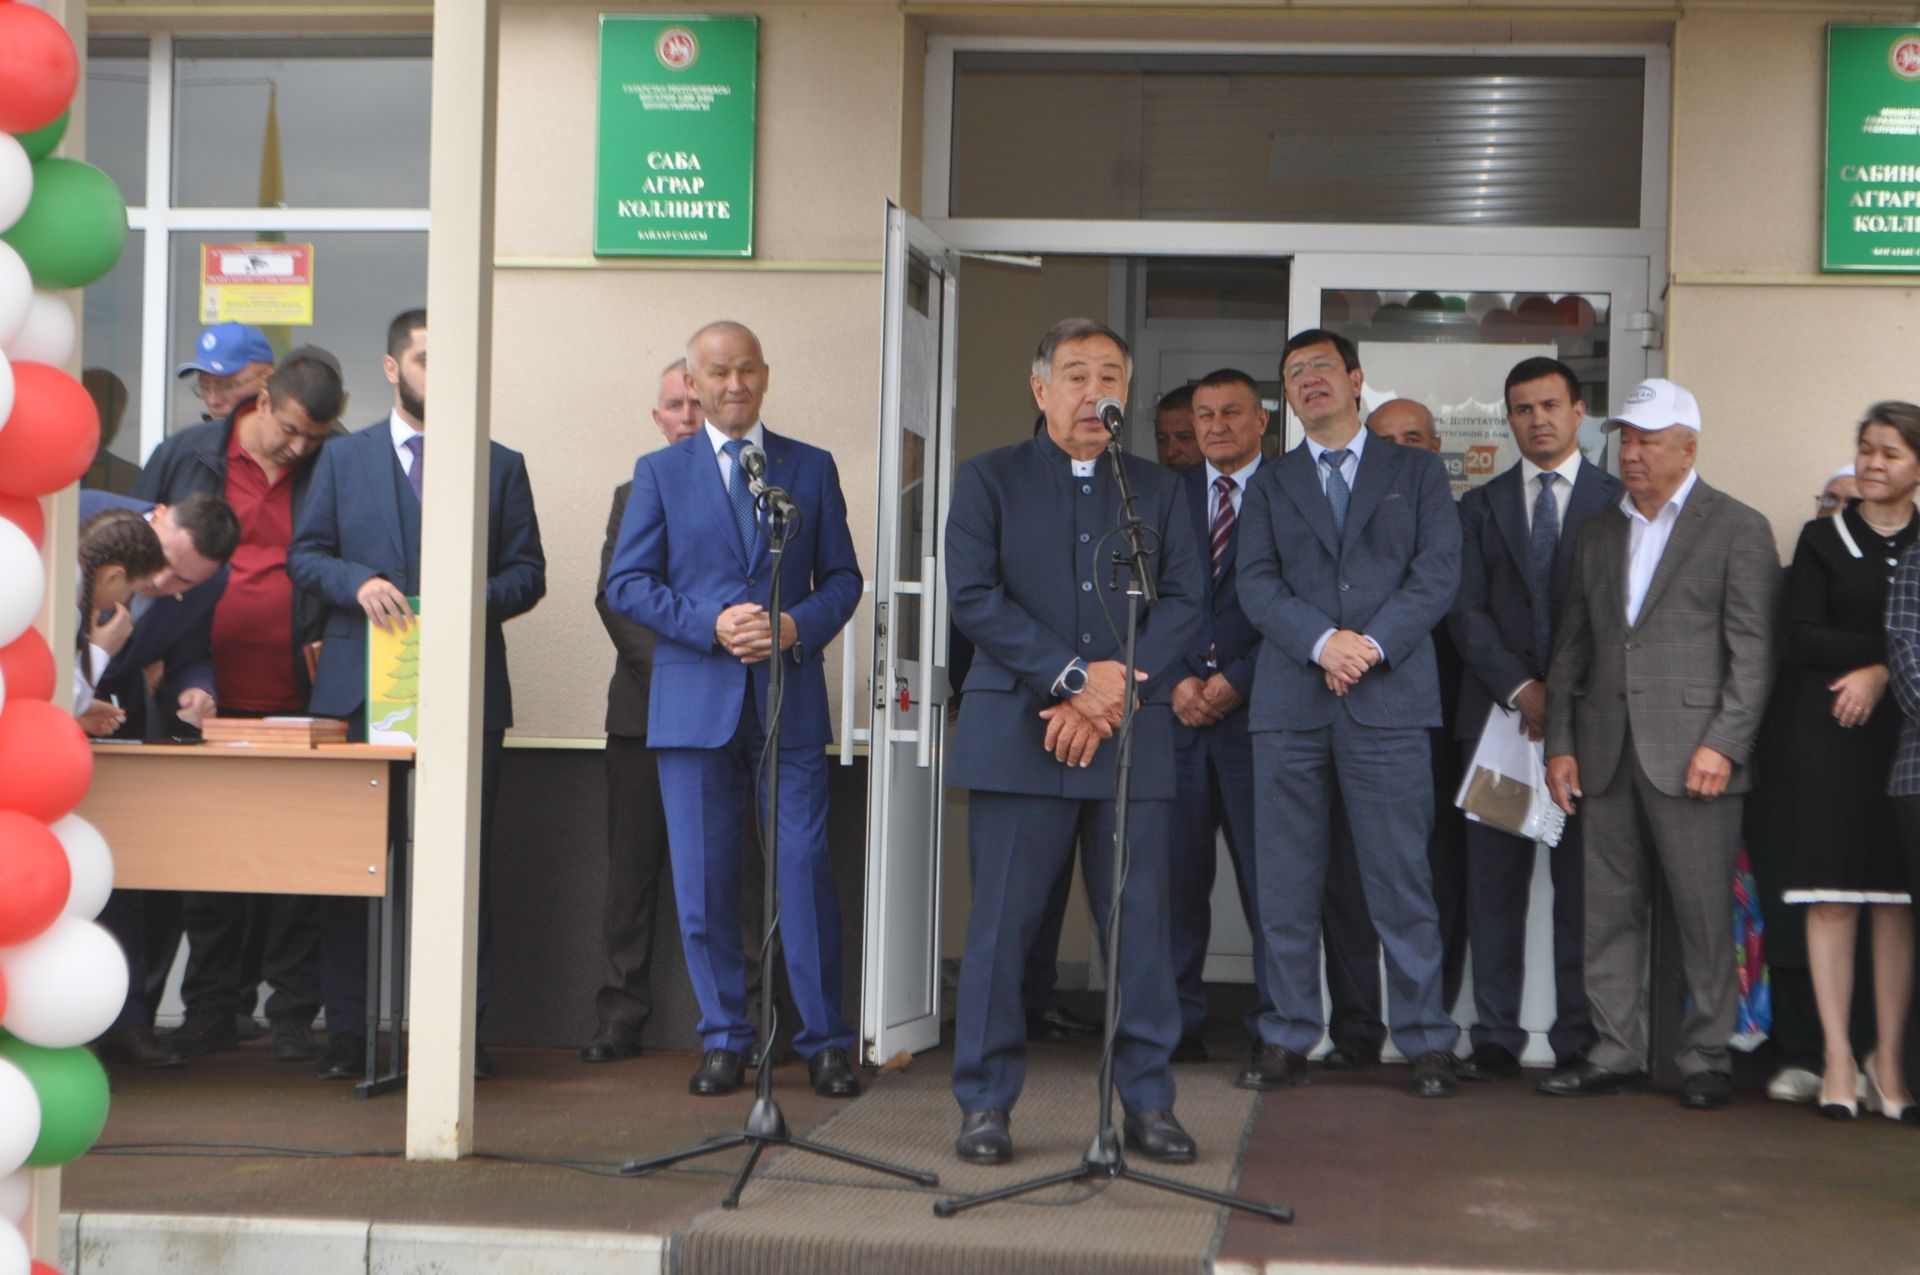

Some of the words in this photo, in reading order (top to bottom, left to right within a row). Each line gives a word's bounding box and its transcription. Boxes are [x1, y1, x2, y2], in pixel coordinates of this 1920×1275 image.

[647, 151, 702, 170] САБА
[642, 175, 705, 195] АГРАР
[1467, 451, 1492, 468] 20
